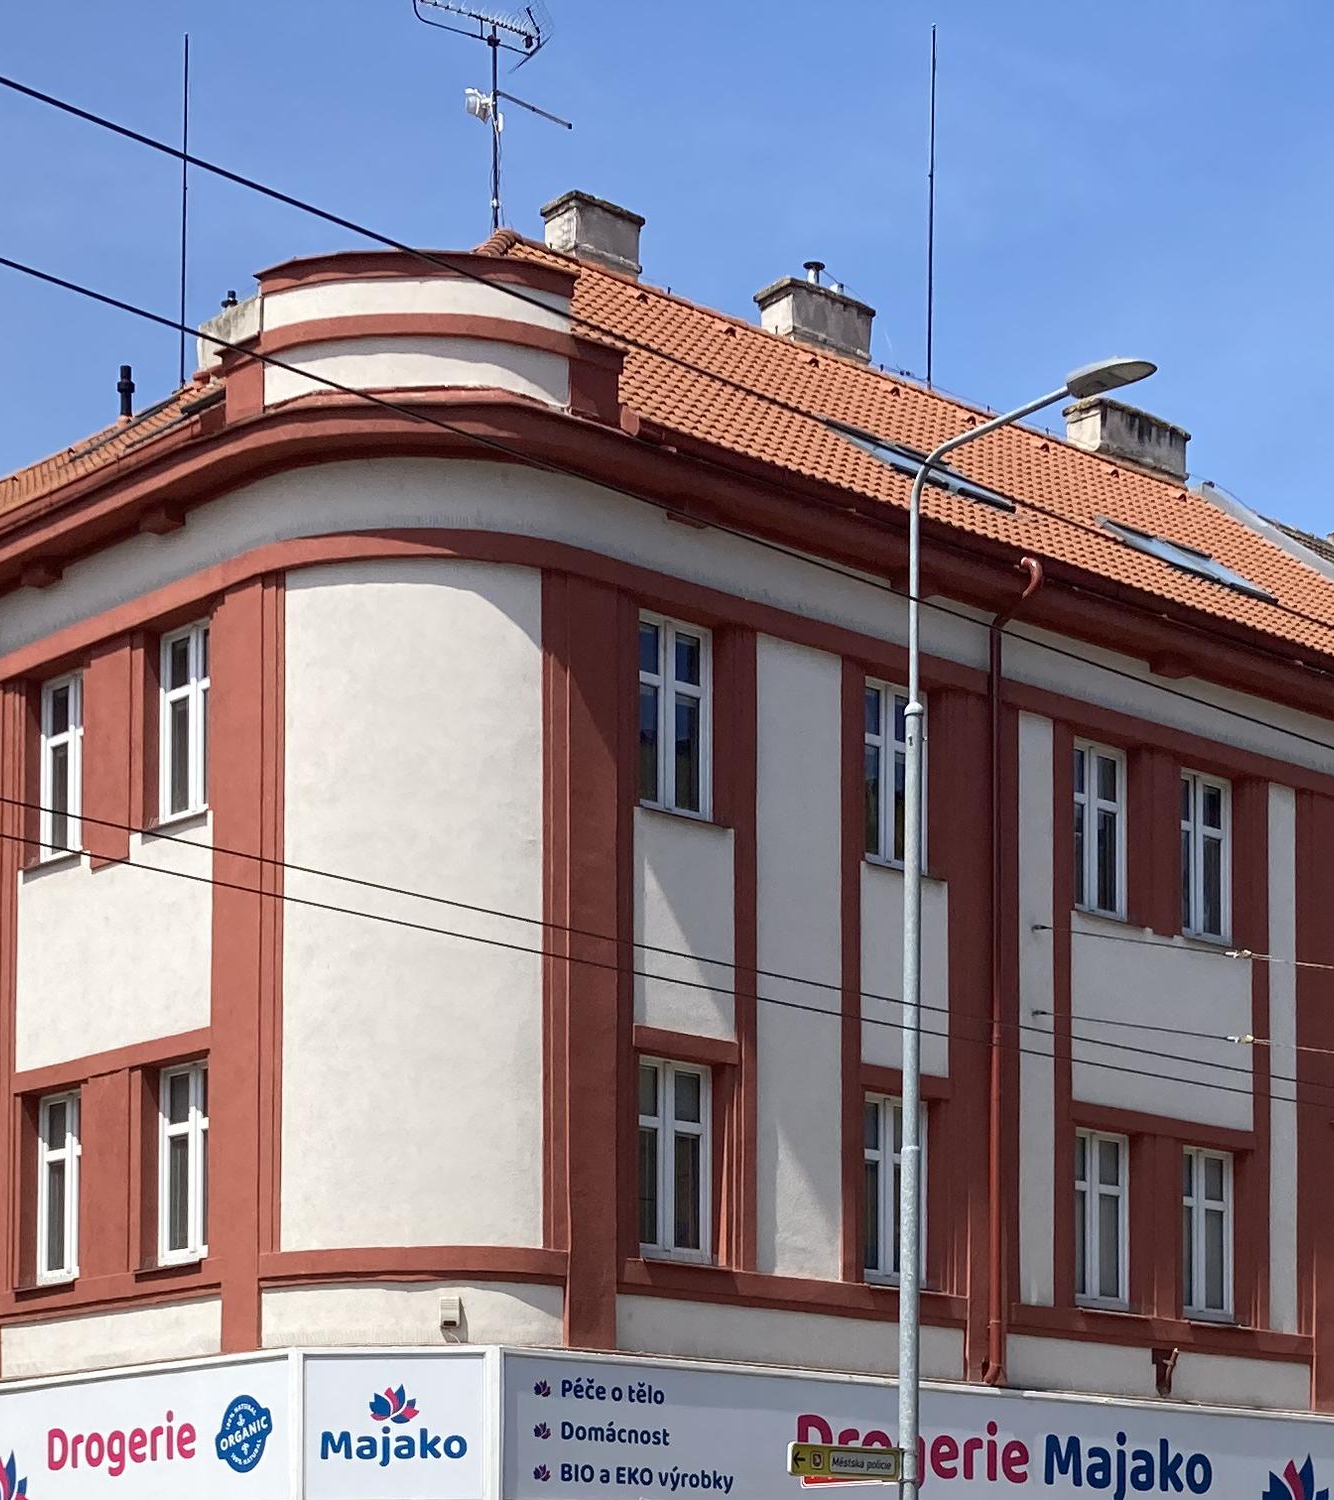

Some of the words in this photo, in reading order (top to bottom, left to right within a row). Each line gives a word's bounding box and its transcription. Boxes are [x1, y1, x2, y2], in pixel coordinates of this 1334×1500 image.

[561, 1377, 606, 1400] Péče
[611, 1387, 623, 1401] o
[628, 1382, 665, 1404] tělo
[48, 1410, 196, 1477] Drogerie
[220, 1416, 268, 1451] ORGANIC
[320, 1426, 467, 1466] Majako
[561, 1421, 670, 1446] Domácnost
[797, 1414, 1029, 1489] Derie
[561, 1463, 594, 1483] BIO
[600, 1469, 610, 1484] a
[617, 1467, 653, 1486] EKO
[658, 1466, 734, 1494] výrobky
